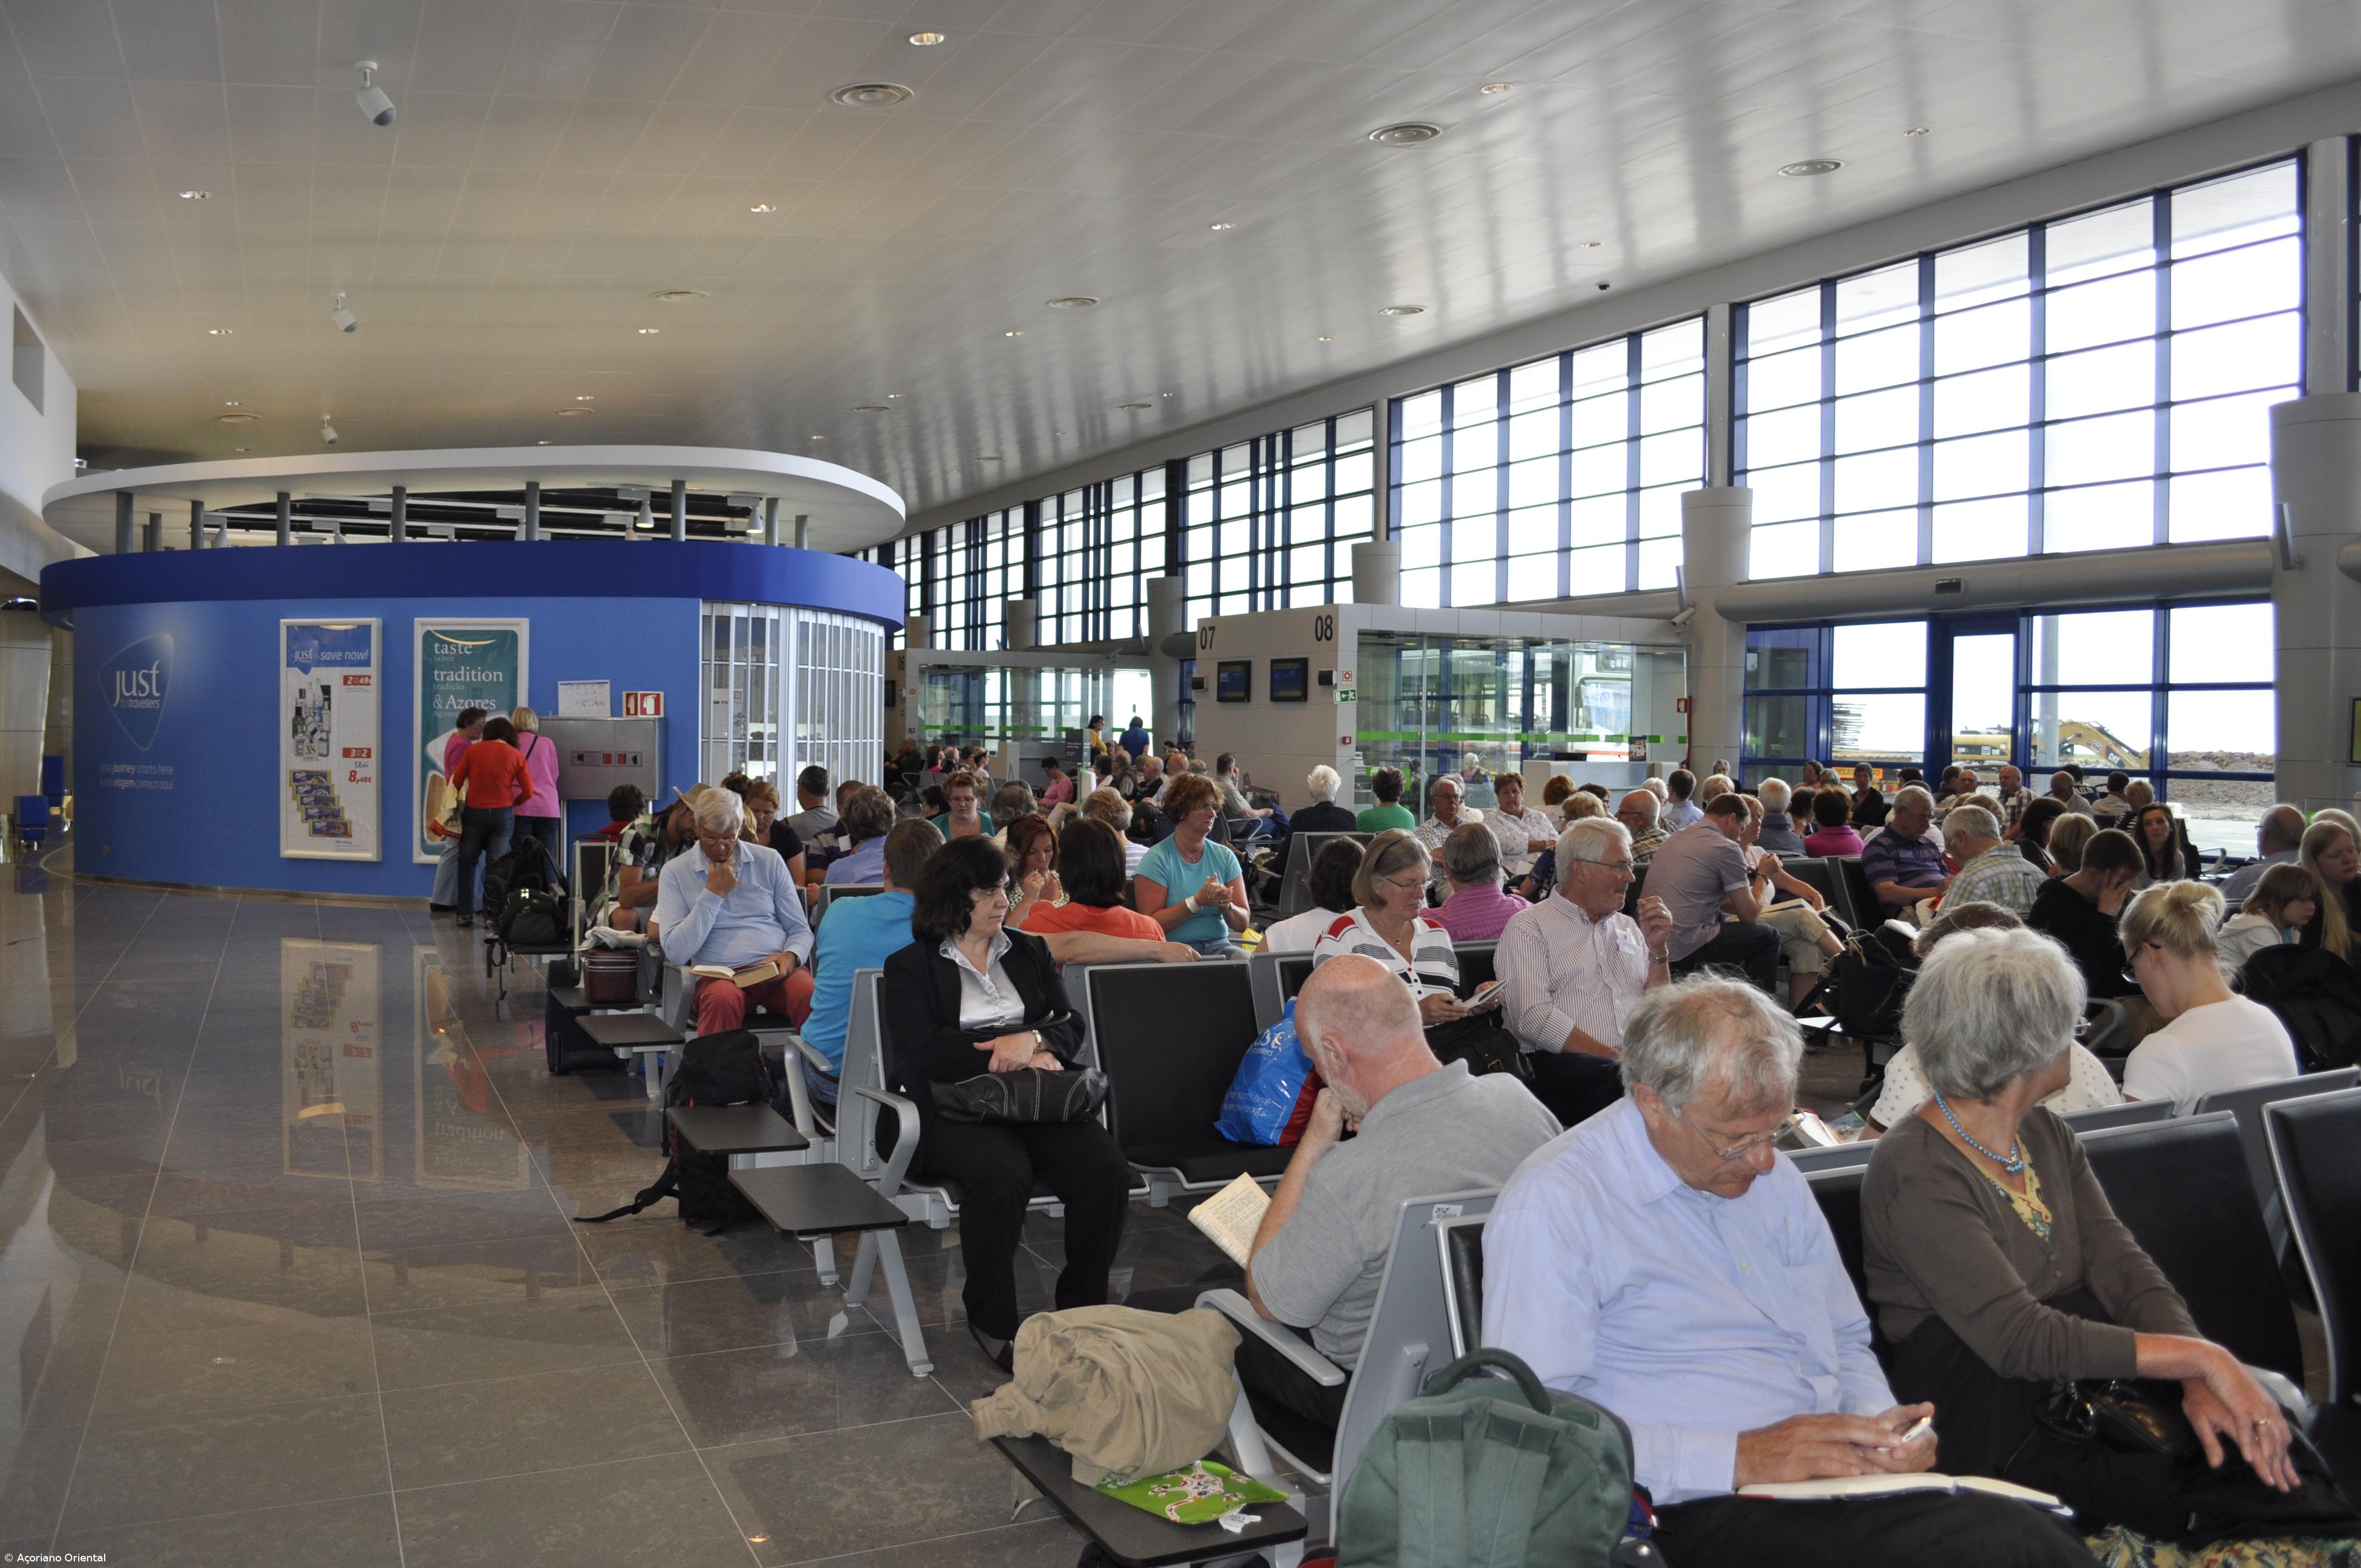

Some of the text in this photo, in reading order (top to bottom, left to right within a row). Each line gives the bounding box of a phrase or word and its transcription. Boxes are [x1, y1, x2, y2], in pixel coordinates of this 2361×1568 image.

[1315, 614, 1333, 642] 08
[1200, 625, 1216, 650] 07
[294, 648, 368, 662] just save now!
[433, 642, 474, 655] taste
[897, 655, 905, 671] 06
[433, 666, 503, 682] tradition
[113, 660, 160, 707] just
[432, 683, 465, 691] tradição
[433, 694, 496, 710] & Azores
[350, 749, 356, 757] 3
[362, 749, 368, 757] 2
[2108, 753, 2121, 765] CAT
[158, 763, 174, 775] here
[1253, 1094, 1271, 1106] here
